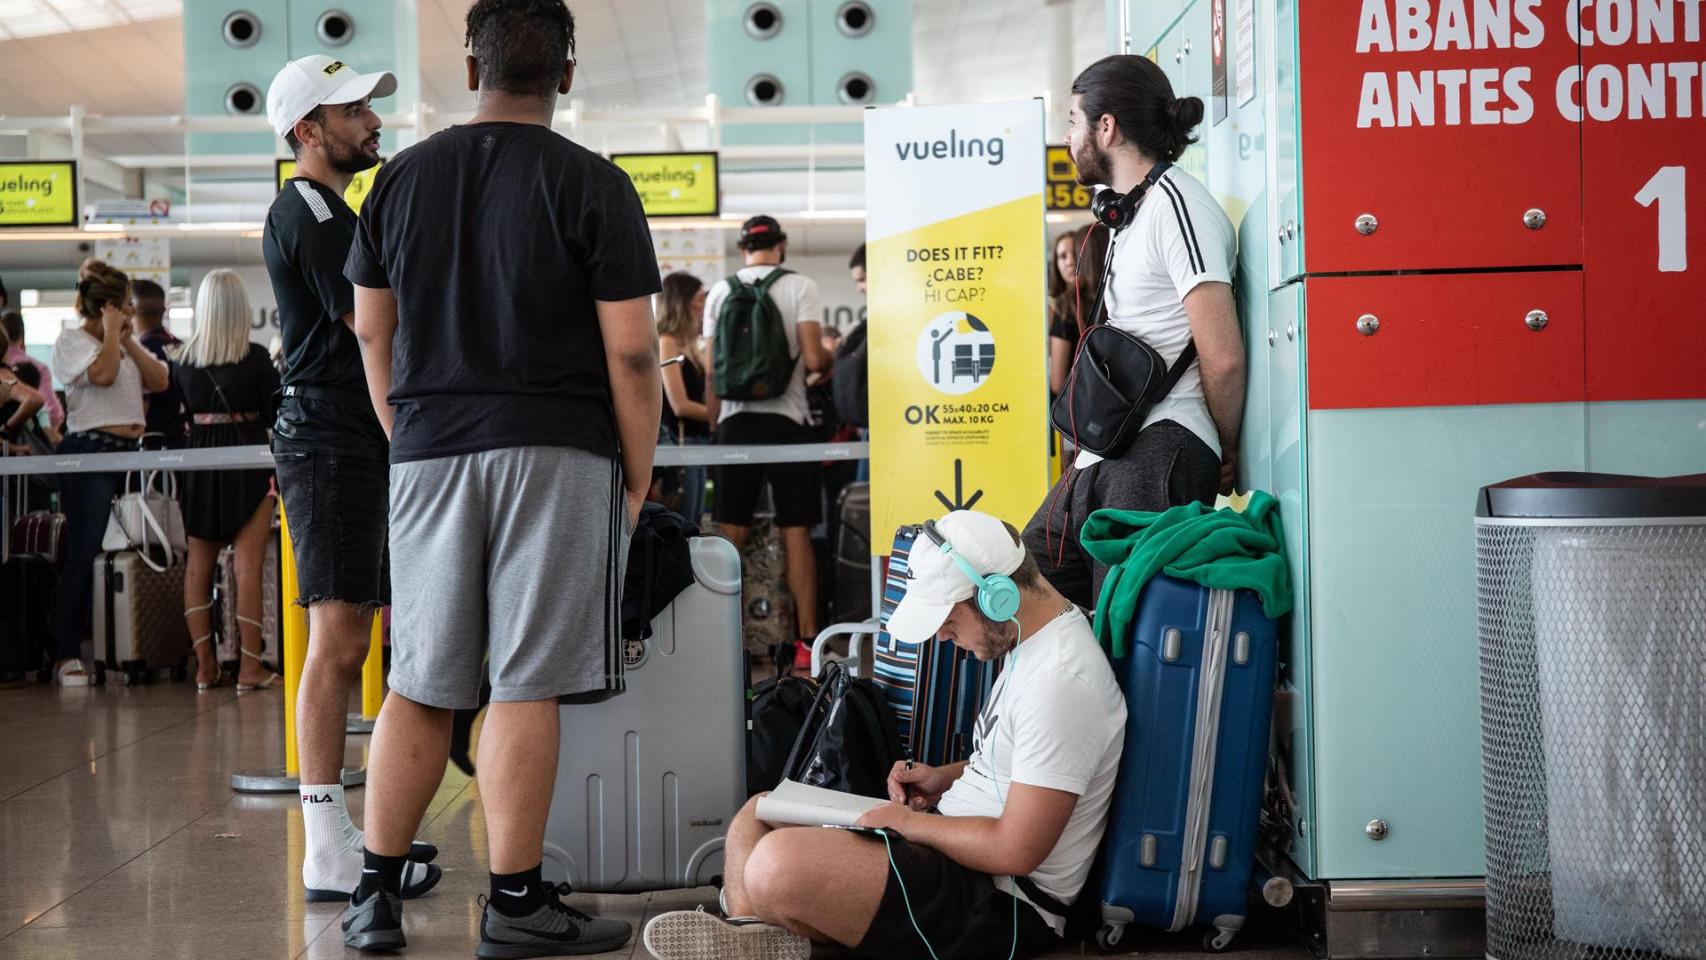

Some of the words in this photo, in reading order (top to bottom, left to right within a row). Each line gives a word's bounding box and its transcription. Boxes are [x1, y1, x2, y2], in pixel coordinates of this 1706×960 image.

[1355, 0, 1545, 53] ABANS
[1356, 66, 1535, 128] ANTES
[1555, 61, 1706, 122] CONT
[896, 129, 1004, 165] vueling
[1634, 166, 1687, 272] 1
[907, 248, 950, 262] DOES
[954, 247, 969, 260] IT
[973, 246, 1004, 260] FIT?
[926, 267, 984, 287] ¿CABE?
[924, 290, 941, 302] HI
[945, 287, 986, 302] CAP?
[904, 405, 940, 425] OK
[992, 403, 1009, 413] CM
[943, 416, 967, 424] MAX.
[969, 415, 979, 424] 10
[980, 415, 994, 424] KG
[302, 793, 334, 804] FILA
